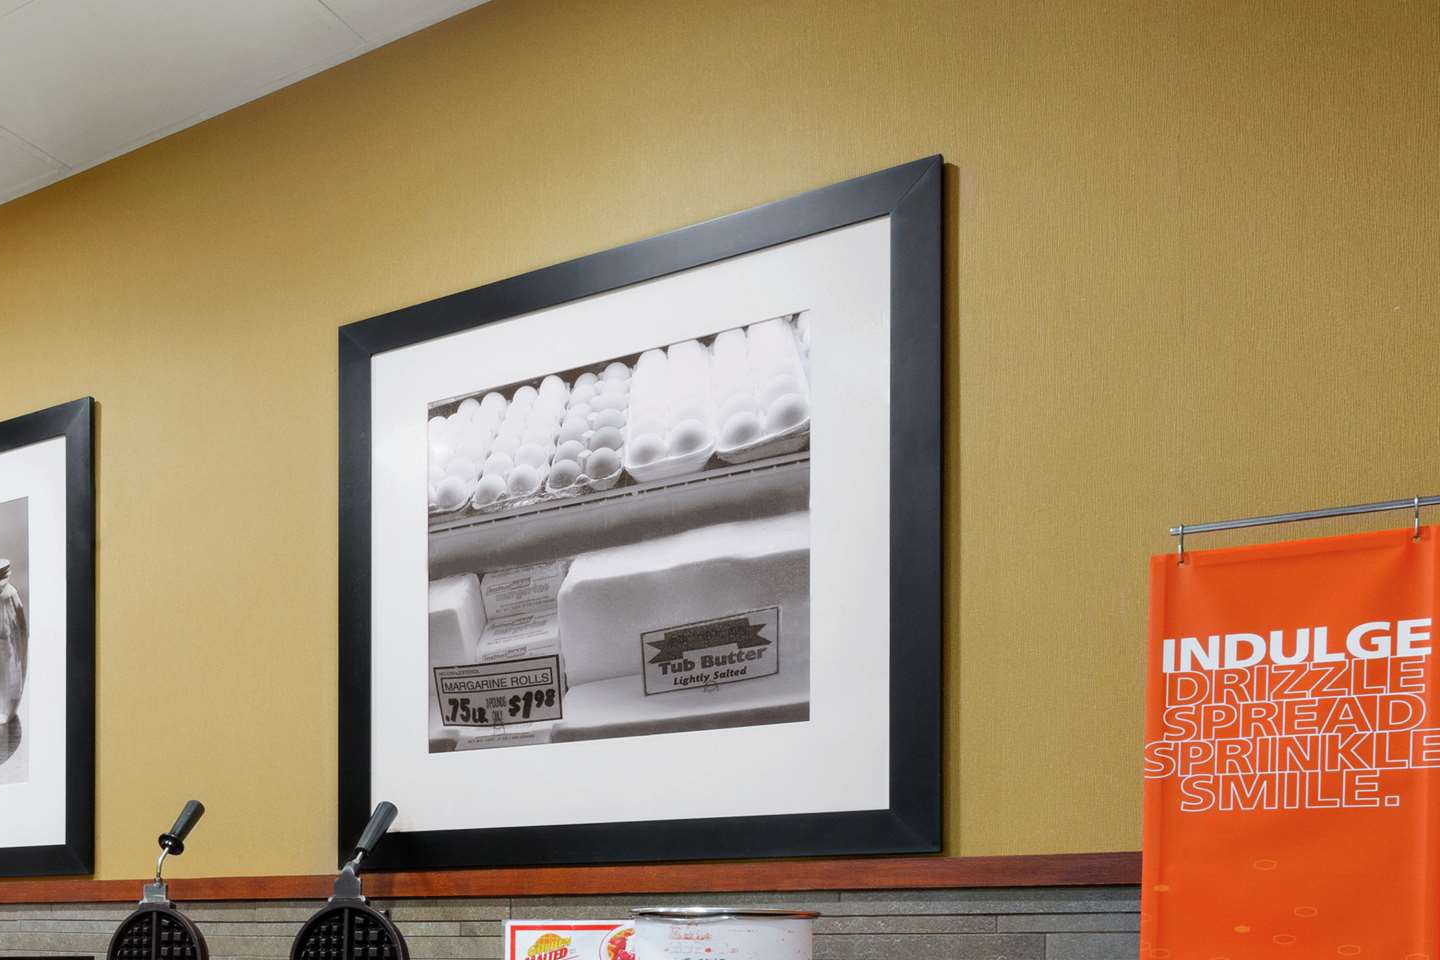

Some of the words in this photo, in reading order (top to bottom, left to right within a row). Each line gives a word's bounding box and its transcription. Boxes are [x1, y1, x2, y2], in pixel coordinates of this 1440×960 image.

[658, 659, 696, 675] Tub
[700, 647, 768, 669] Butter
[1163, 618, 1432, 673] INDULGE
[444, 678, 508, 692] MARGARINE
[511, 672, 550, 687] ROLLS
[673, 672, 711, 686] Lightly
[713, 666, 748, 680] Salted
[1166, 655, 1426, 708] DRIZZLE
[1163, 692, 1427, 742] SPREAD
[1144, 728, 1440, 779] SPRINKLE
[1181, 768, 1400, 812] SMILE.
